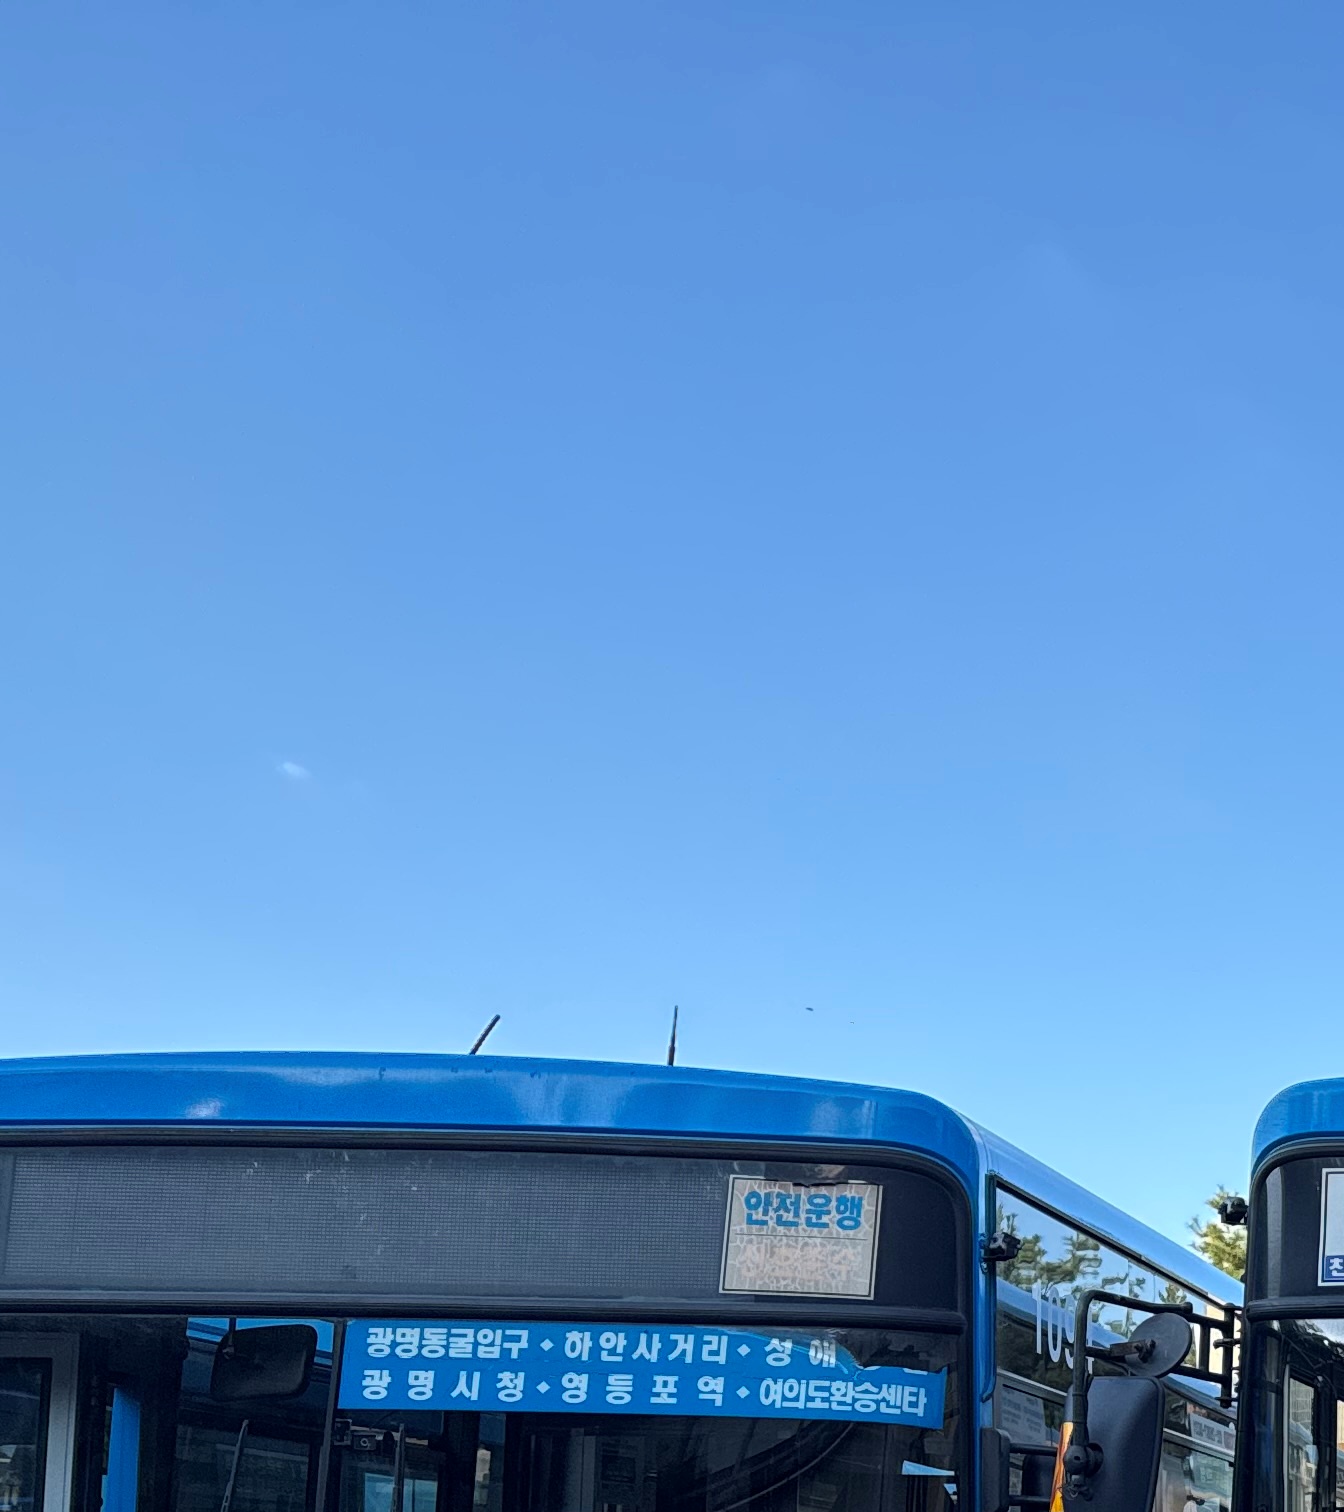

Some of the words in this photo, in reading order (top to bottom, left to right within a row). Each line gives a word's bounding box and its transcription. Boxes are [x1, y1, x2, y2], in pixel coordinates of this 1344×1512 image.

[743, 1190, 864, 1231] 안전운행
[366, 1327, 529, 1359] 광명동굴입구
[564, 1330, 729, 1365] 하안사거리
[361, 1368, 525, 1403] 광명시청
[560, 1371, 724, 1407] 영등포역
[759, 1377, 928, 1417] 여의도환승센타
